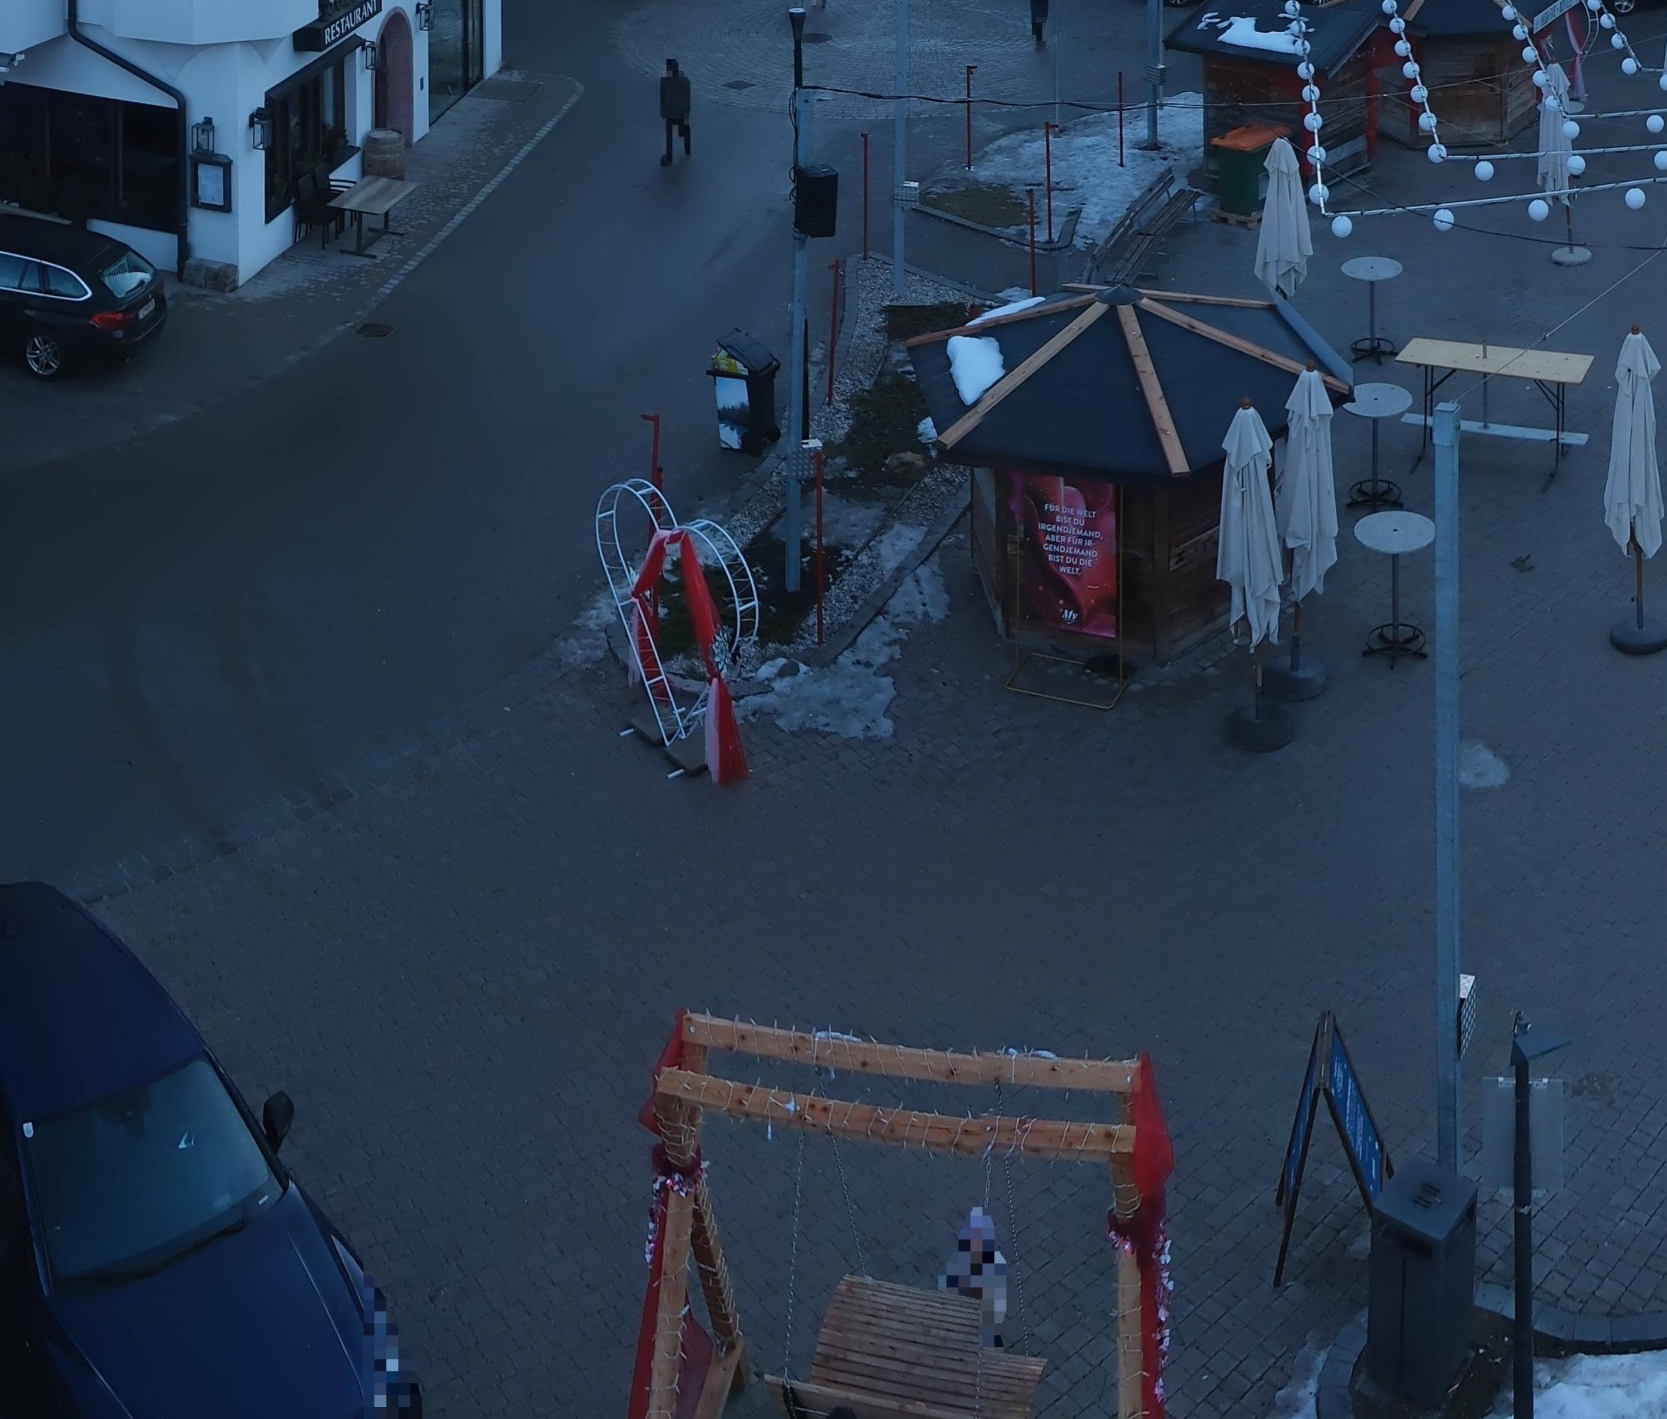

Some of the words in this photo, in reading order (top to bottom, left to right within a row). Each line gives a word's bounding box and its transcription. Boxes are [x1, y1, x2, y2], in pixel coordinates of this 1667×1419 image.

[1044, 502, 1060, 512] FÜR
[1061, 506, 1075, 515] DIE
[1076, 509, 1097, 518] WELT
[1055, 515, 1072, 524] BIST
[1073, 518, 1085, 527] DU
[1038, 522, 1103, 540] IRGENDJEMAND,
[1045, 533, 1066, 543] ABER
[1067, 535, 1083, 546] FÜR
[1043, 543, 1098, 558] GENDJEMAND
[1048, 554, 1064, 563] BIST
[1065, 556, 1078, 565] DU
[1079, 557, 1093, 567] DIE
[1061, 608, 1079, 625] My
